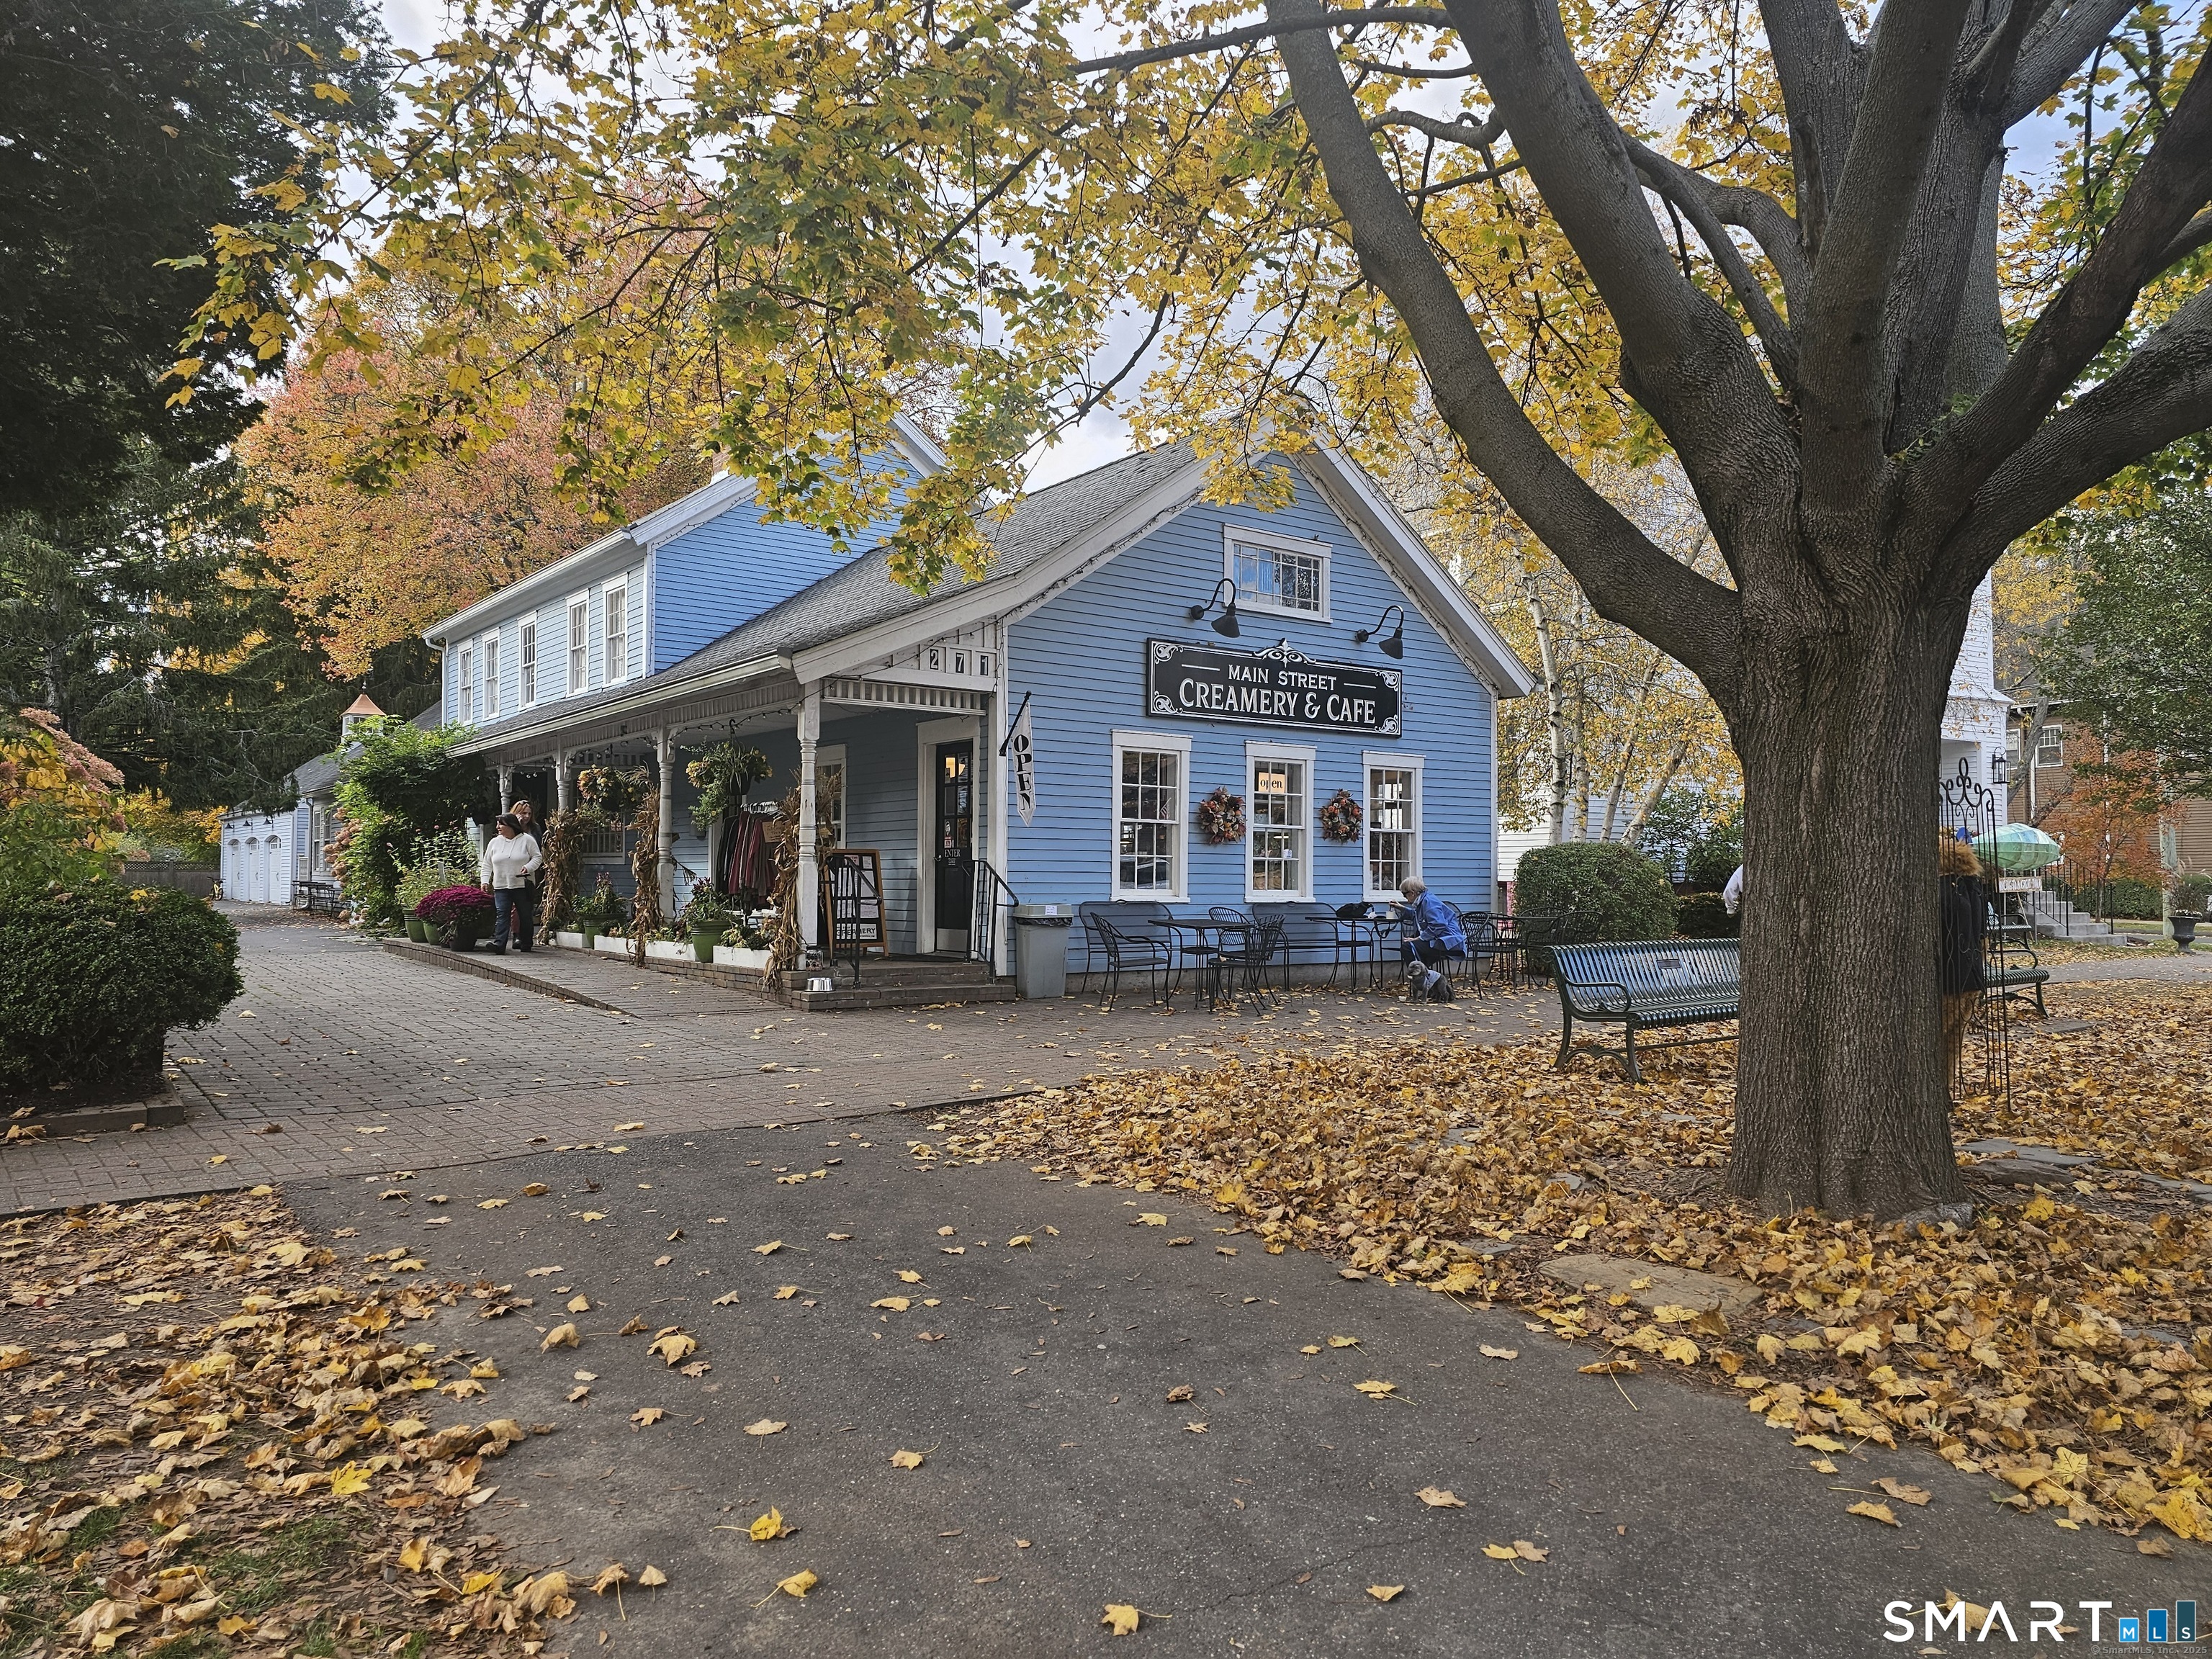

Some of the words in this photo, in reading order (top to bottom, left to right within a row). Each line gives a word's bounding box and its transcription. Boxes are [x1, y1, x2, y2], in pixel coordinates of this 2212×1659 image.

[930, 650, 988, 675] 271
[1228, 665, 1269, 683] MAIN
[1277, 670, 1337, 691] STREET
[1179, 678, 1298, 716] CREAMERY
[1304, 691, 1321, 719] &
[1326, 694, 1376, 724] CAFE
[1014, 734, 1032, 810] OPEN
[944, 849, 961, 858] ENTER
